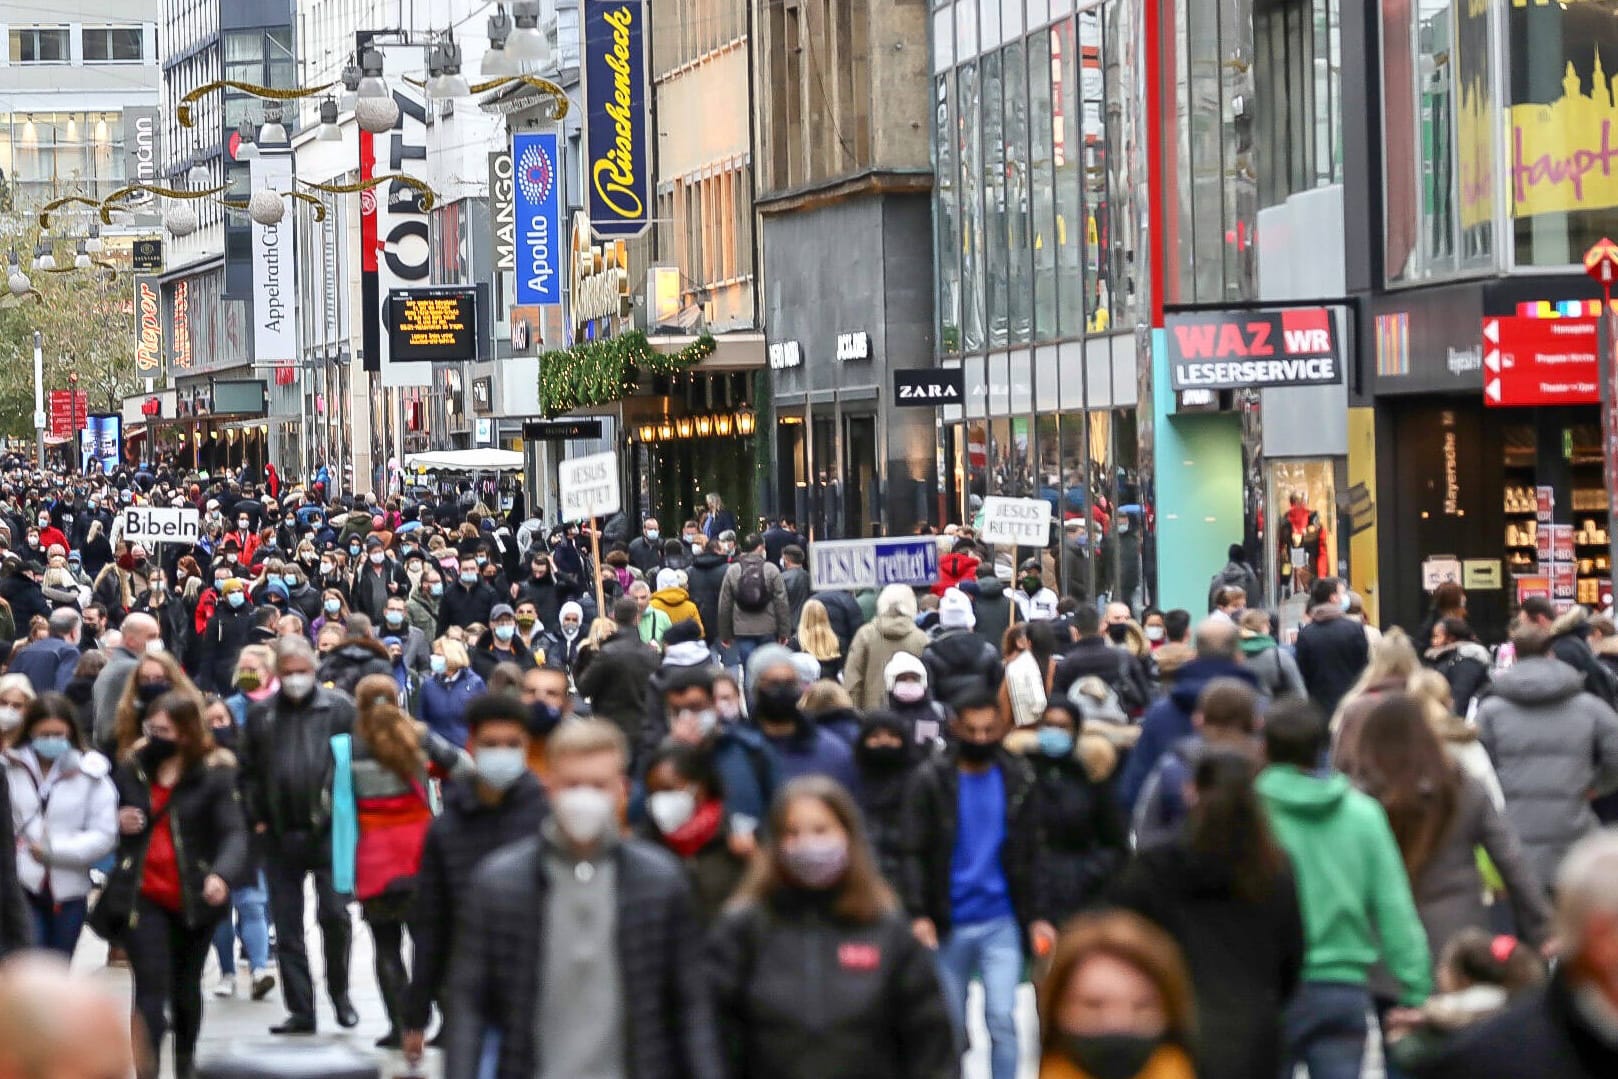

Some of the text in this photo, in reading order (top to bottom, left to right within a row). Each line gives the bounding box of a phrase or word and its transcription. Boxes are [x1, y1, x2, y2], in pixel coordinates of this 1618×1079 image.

[593, 6, 643, 219] Rüschenbeck
[494, 154, 514, 268] MANGO
[526, 215, 554, 294] Apollo
[137, 281, 161, 371] Pieper
[1174, 322, 1331, 359] WAZ WR
[1176, 358, 1335, 385] LESERSERVICE
[899, 384, 958, 399] ZARA
[126, 511, 197, 536] Bibeln
[997, 504, 1040, 519] JESUS
[990, 520, 1041, 537] RETTET
